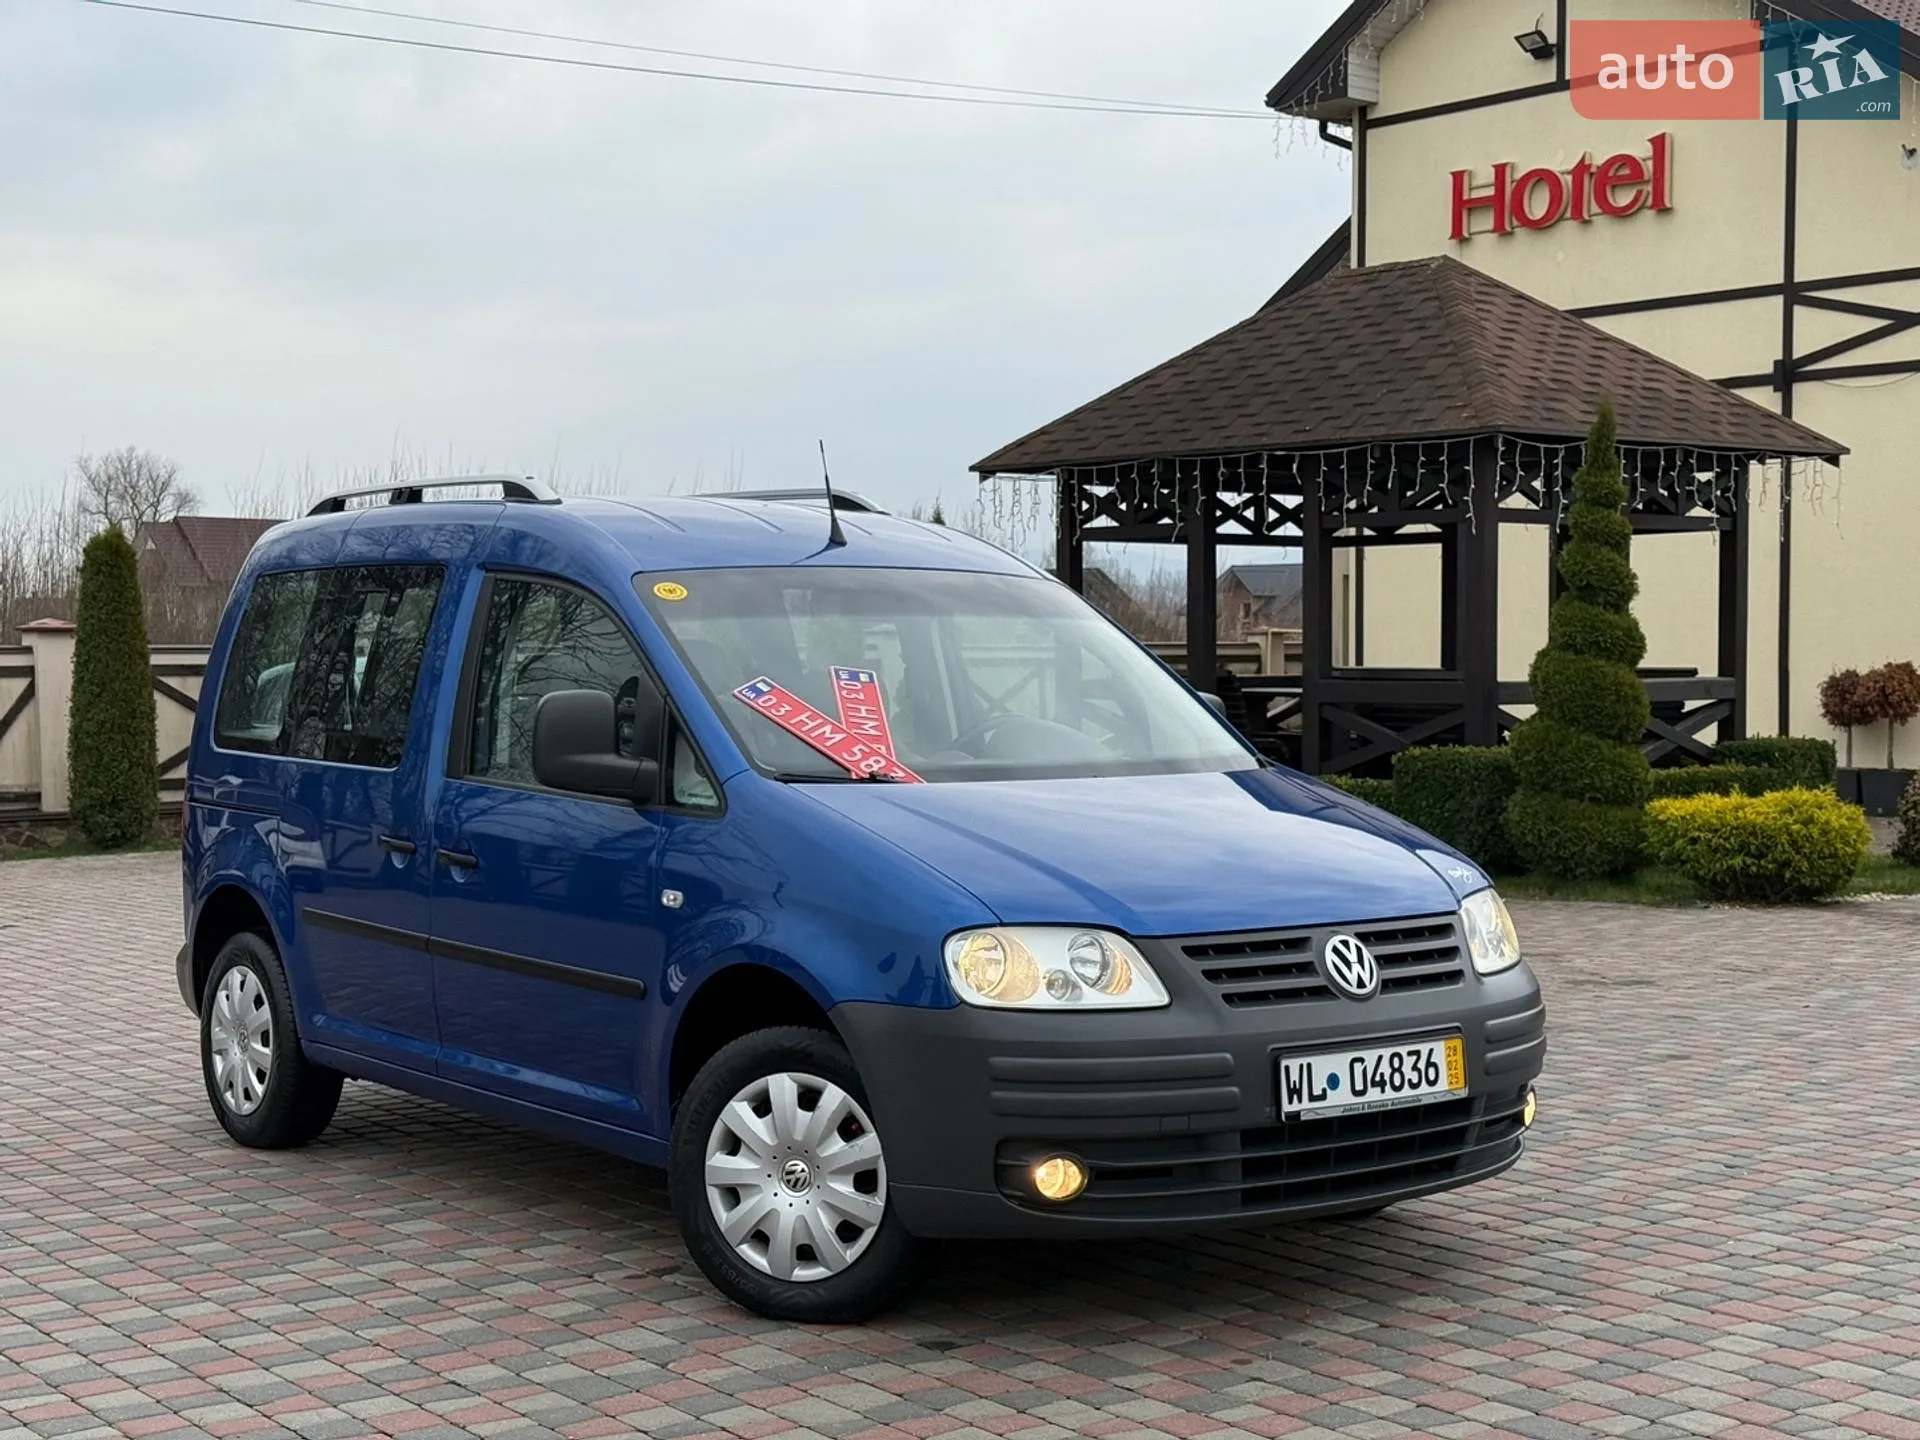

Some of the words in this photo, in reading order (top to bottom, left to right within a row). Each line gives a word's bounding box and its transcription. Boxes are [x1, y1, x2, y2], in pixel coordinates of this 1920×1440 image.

[1448, 132, 1673, 240] Hotel
[742, 688, 757, 700] UA
[757, 694, 793, 717] 03
[789, 711, 848, 748] HM
[1284, 1062, 1328, 1105] WL
[1349, 1048, 1440, 1098] 04836
